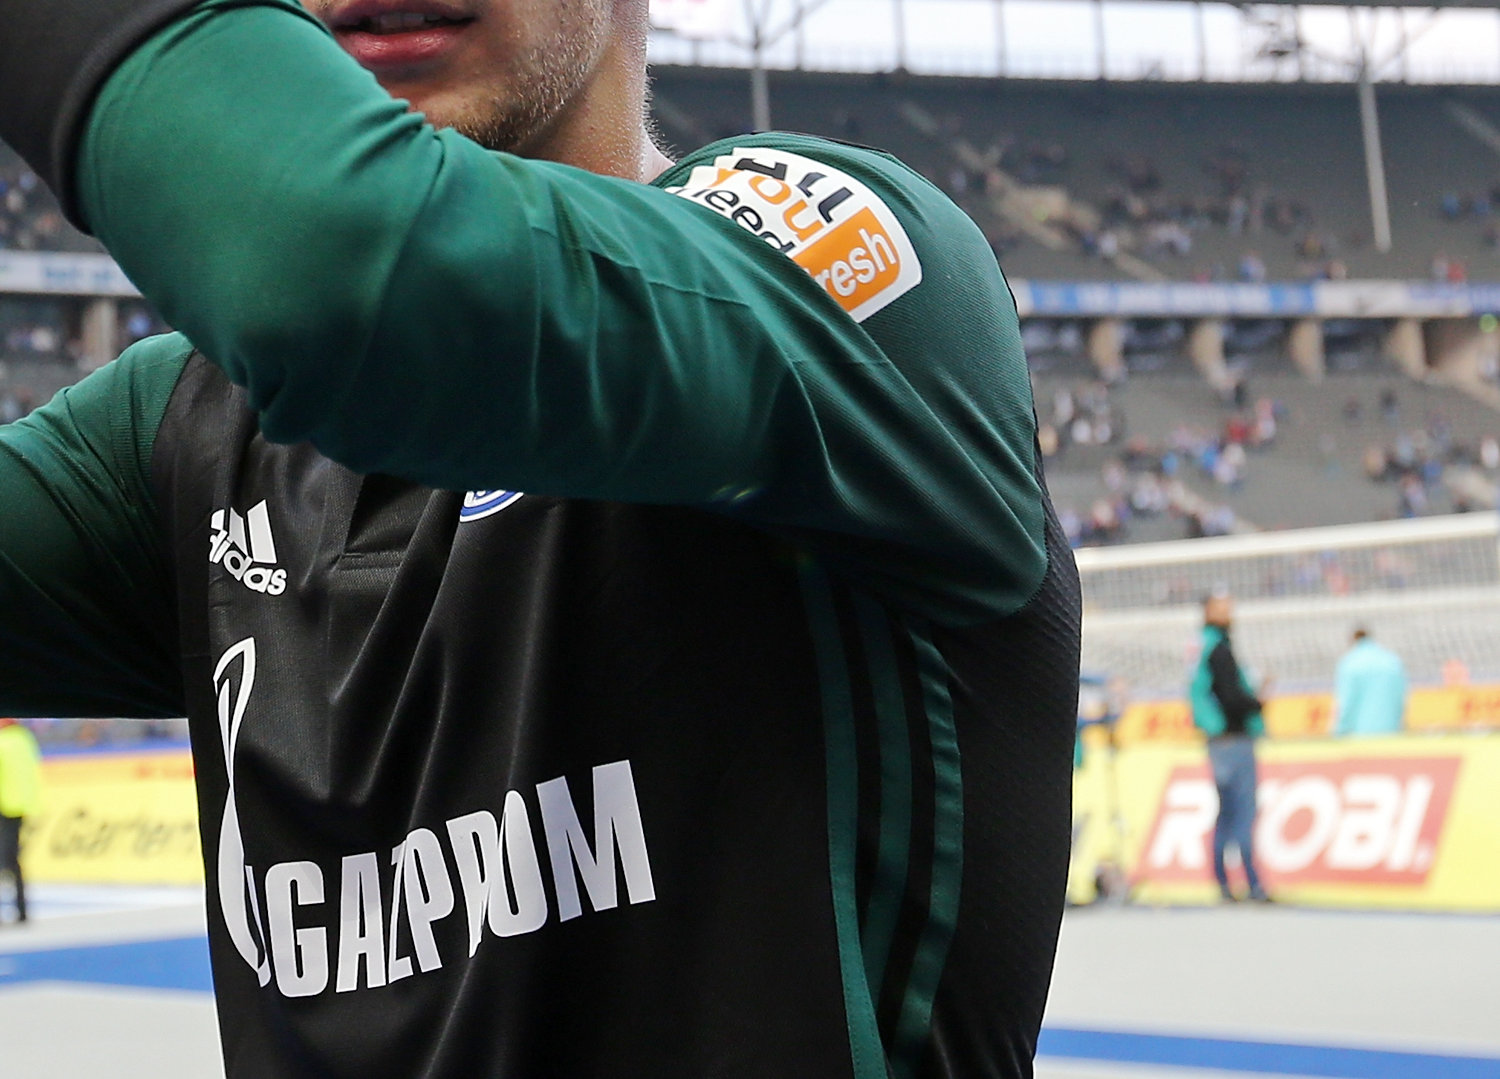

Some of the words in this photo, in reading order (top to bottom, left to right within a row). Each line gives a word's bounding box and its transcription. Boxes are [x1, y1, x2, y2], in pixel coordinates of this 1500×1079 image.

[672, 188, 796, 253] eed
[803, 227, 897, 297] resh
[1148, 774, 1437, 874] ROBI
